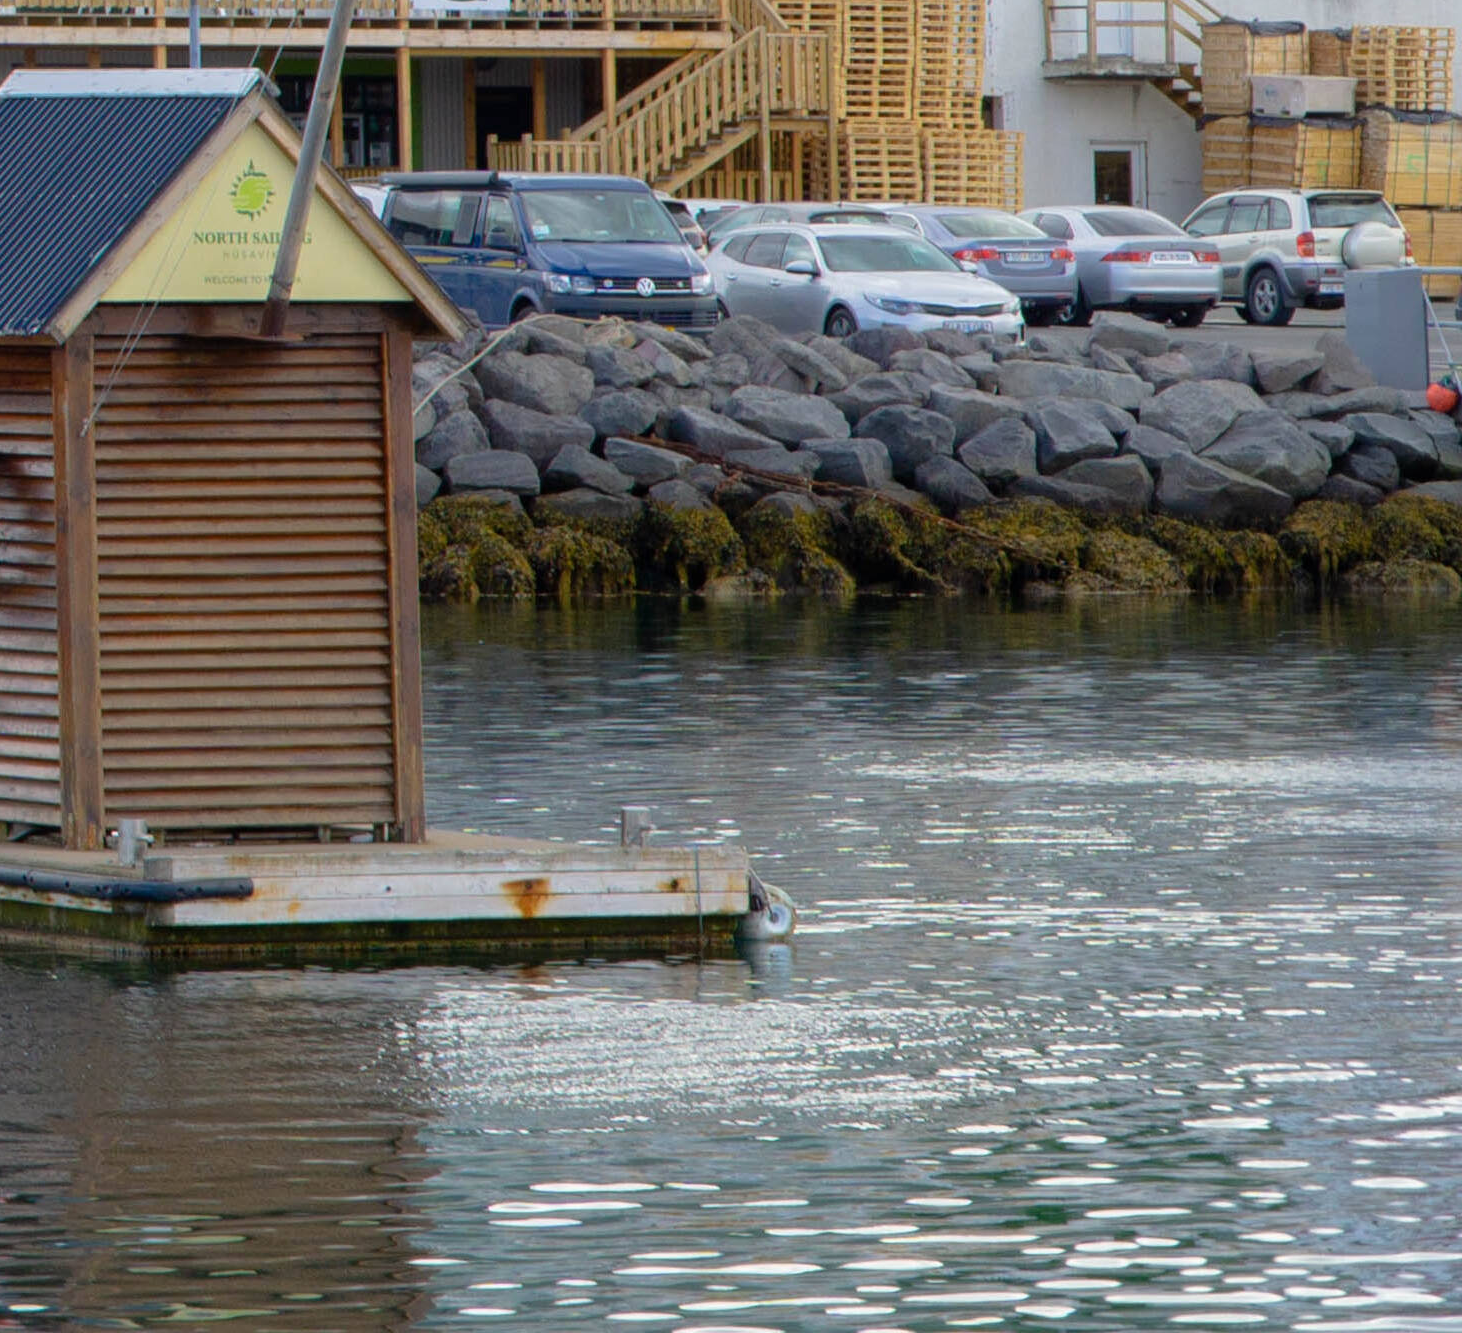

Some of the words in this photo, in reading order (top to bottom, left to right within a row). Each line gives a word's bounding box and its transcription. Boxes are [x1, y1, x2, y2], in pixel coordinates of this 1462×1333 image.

[193, 231, 248, 245] NORTH
[203, 275, 248, 285] WELCOME
[250, 275, 263, 285] TO
